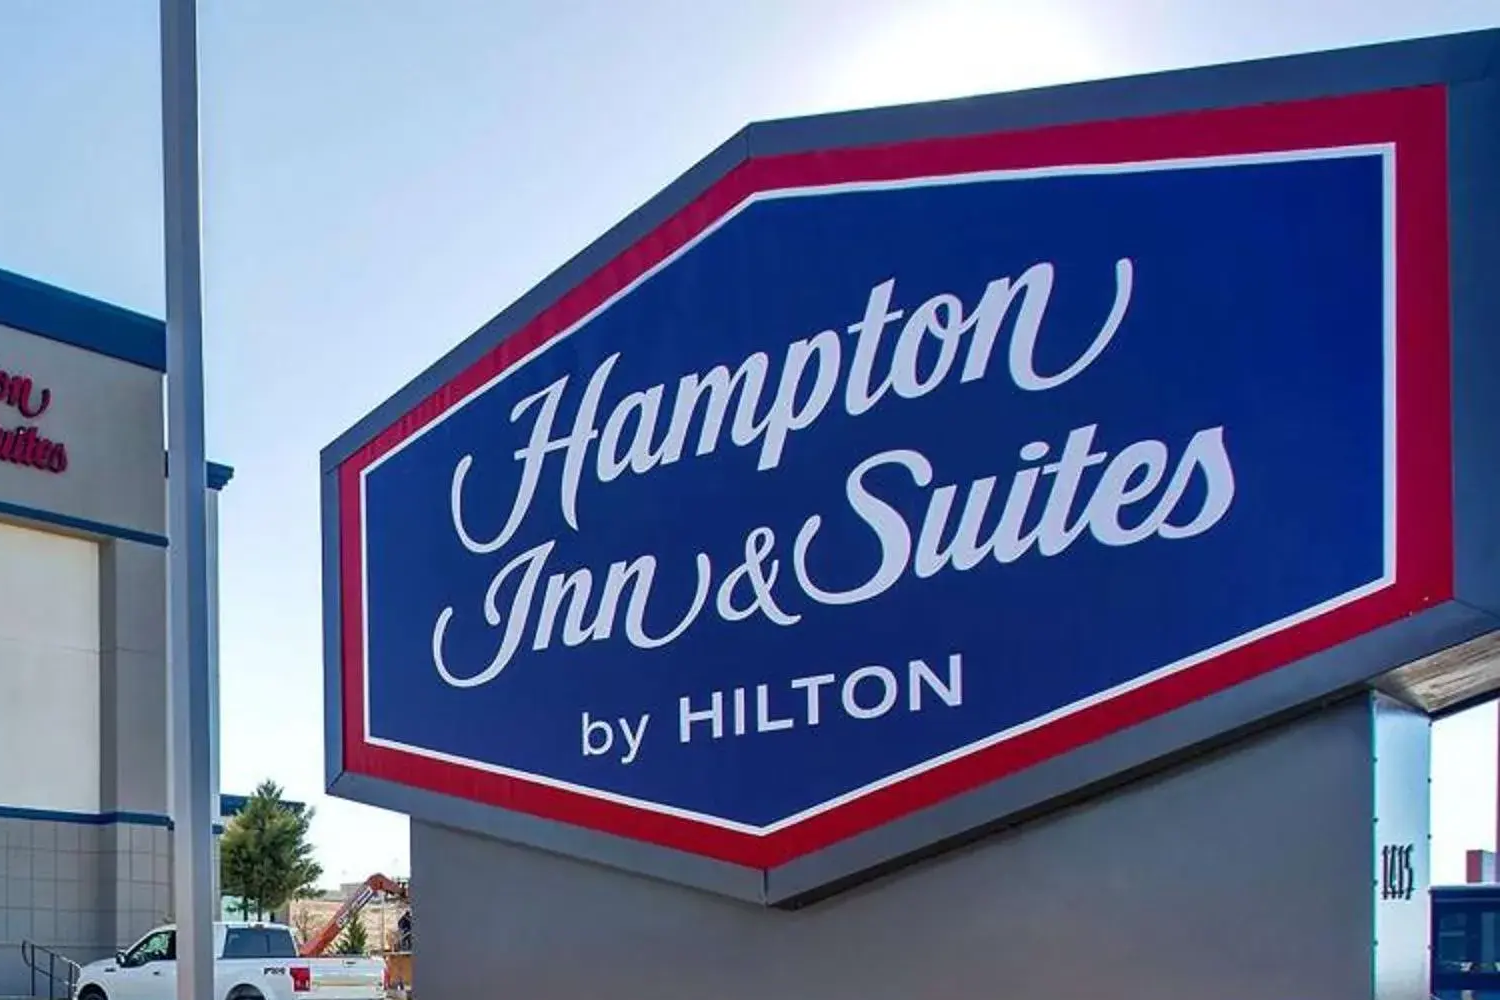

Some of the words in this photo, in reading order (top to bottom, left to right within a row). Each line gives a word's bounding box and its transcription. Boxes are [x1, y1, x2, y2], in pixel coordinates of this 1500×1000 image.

[451, 258, 1133, 553] Hampton
[432, 540, 711, 688] Inn
[716, 526, 802, 626] &
[793, 424, 1235, 605] Suites
[582, 711, 649, 764] by
[679, 654, 963, 743] HILTON
[1381, 844, 1416, 900] 1415
